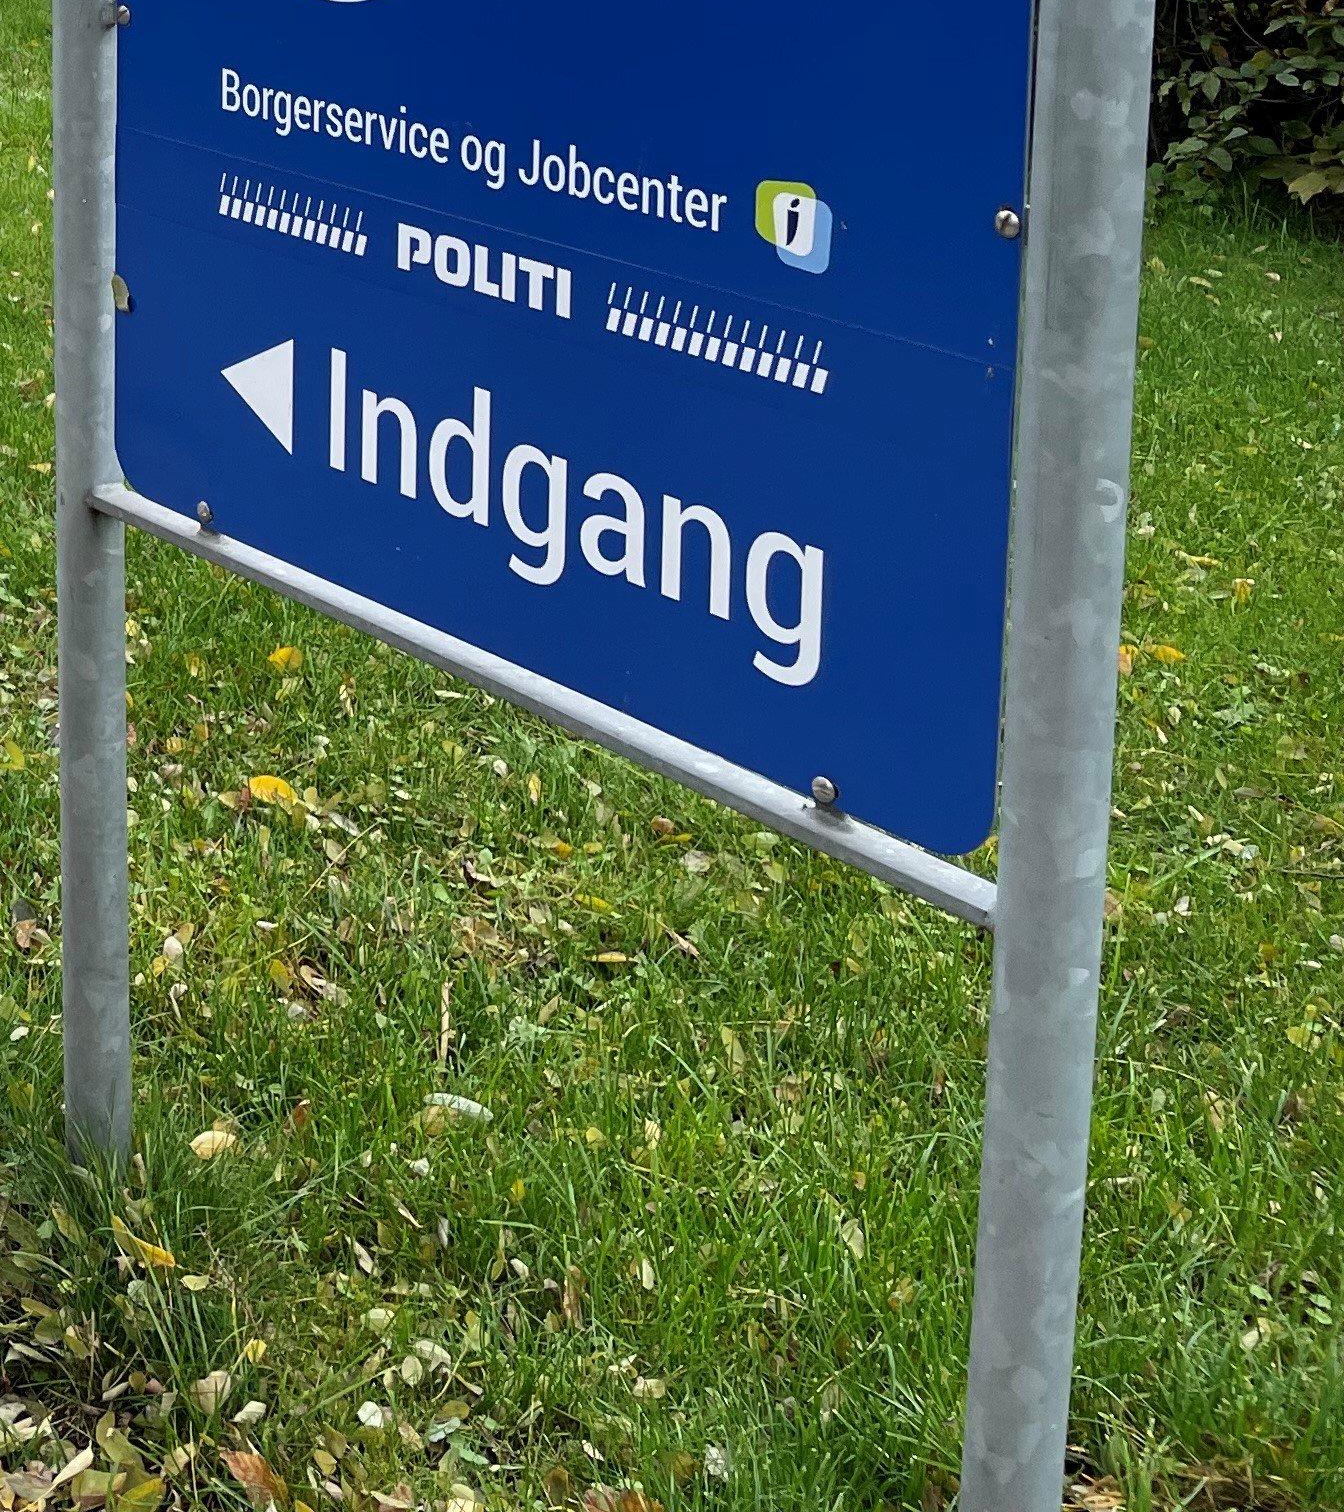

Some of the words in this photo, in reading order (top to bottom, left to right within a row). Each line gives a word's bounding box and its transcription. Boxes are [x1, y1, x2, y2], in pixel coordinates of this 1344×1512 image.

[220, 66, 450, 165] Borgerservice
[460, 135, 506, 191] og
[518, 138, 728, 233] Jobcenter
[396, 221, 573, 320] POLITI
[328, 346, 825, 688] Indgang
